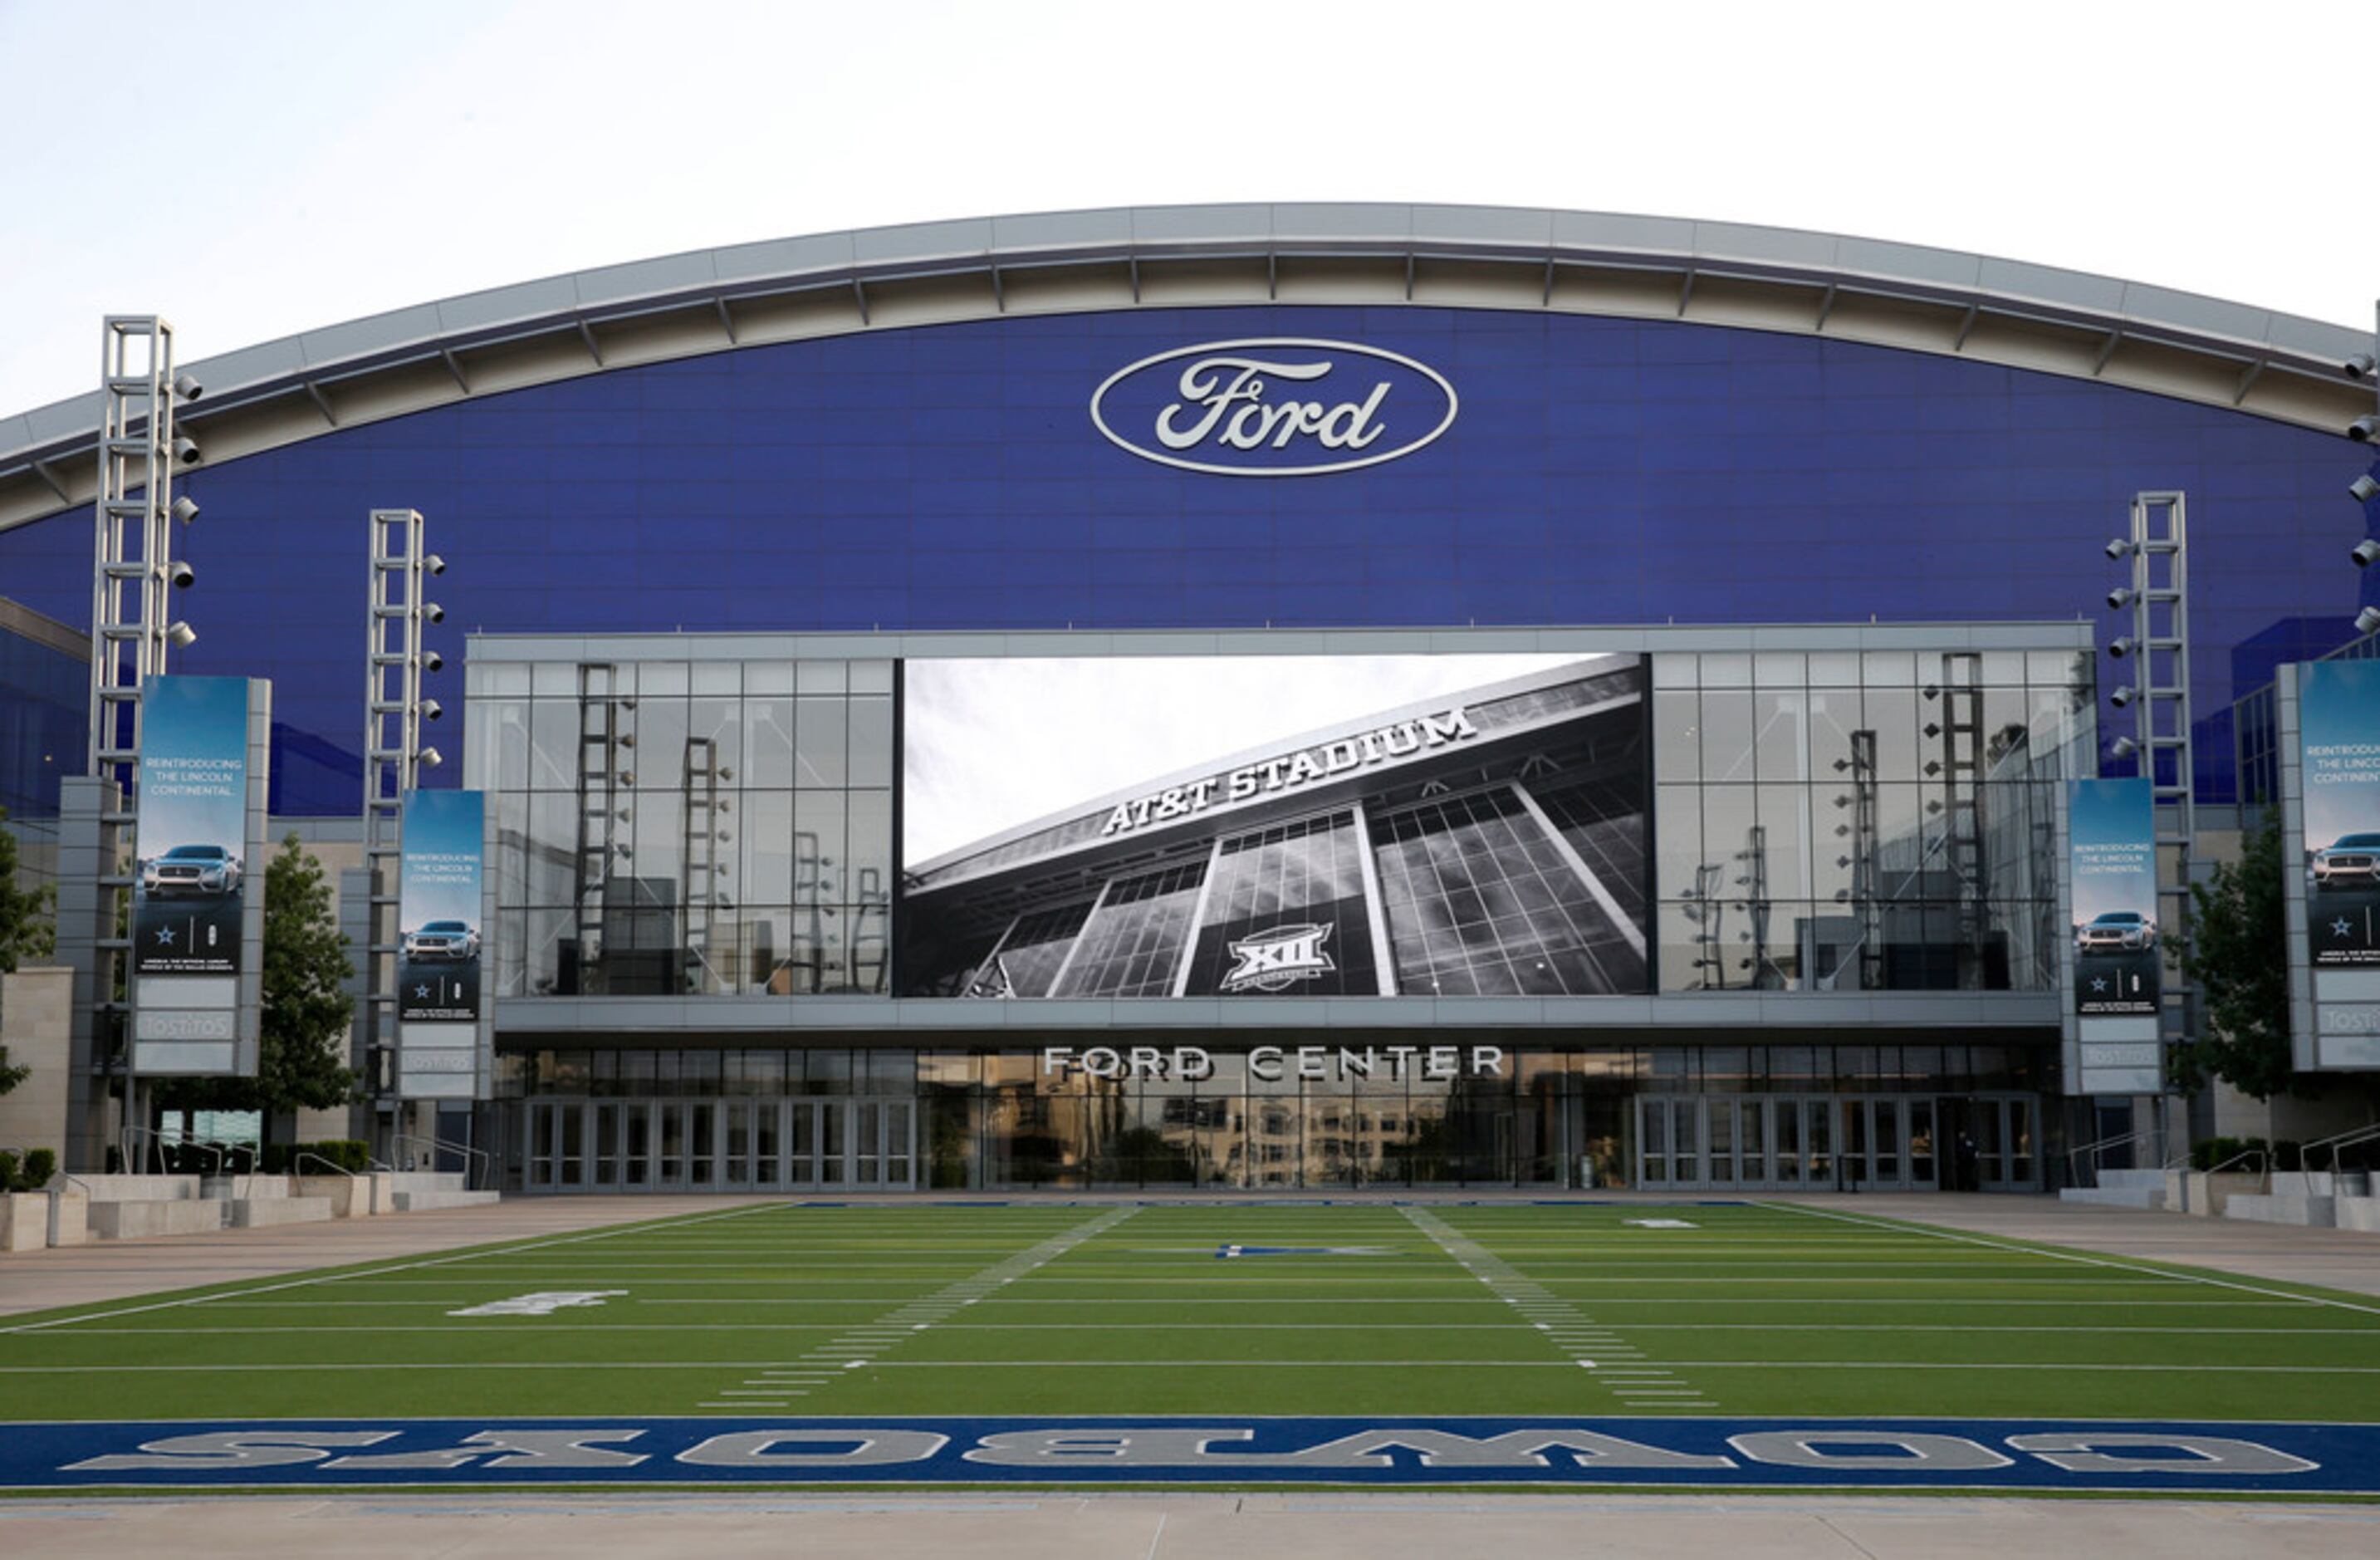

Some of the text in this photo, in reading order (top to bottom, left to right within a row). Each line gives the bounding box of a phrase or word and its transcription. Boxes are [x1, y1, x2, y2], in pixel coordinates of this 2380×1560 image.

[1156, 357, 1393, 449] Ford
[146, 758, 242, 771] REINTRODUCING
[2317, 758, 2339, 769] THE
[156, 771, 233, 782] THE LINCOLN
[1101, 707, 1478, 836] AT&T STADIUM
[2074, 842, 2150, 852] REINTRODUCING
[406, 852, 479, 862] REINTRODUCING
[2082, 854, 2144, 864] THE LINCOLN
[413, 864, 473, 873] THE LINCOLN
[1043, 1045, 1505, 1077] FORD CENTER
[57, 1428, 2322, 1474] COWBOYS
